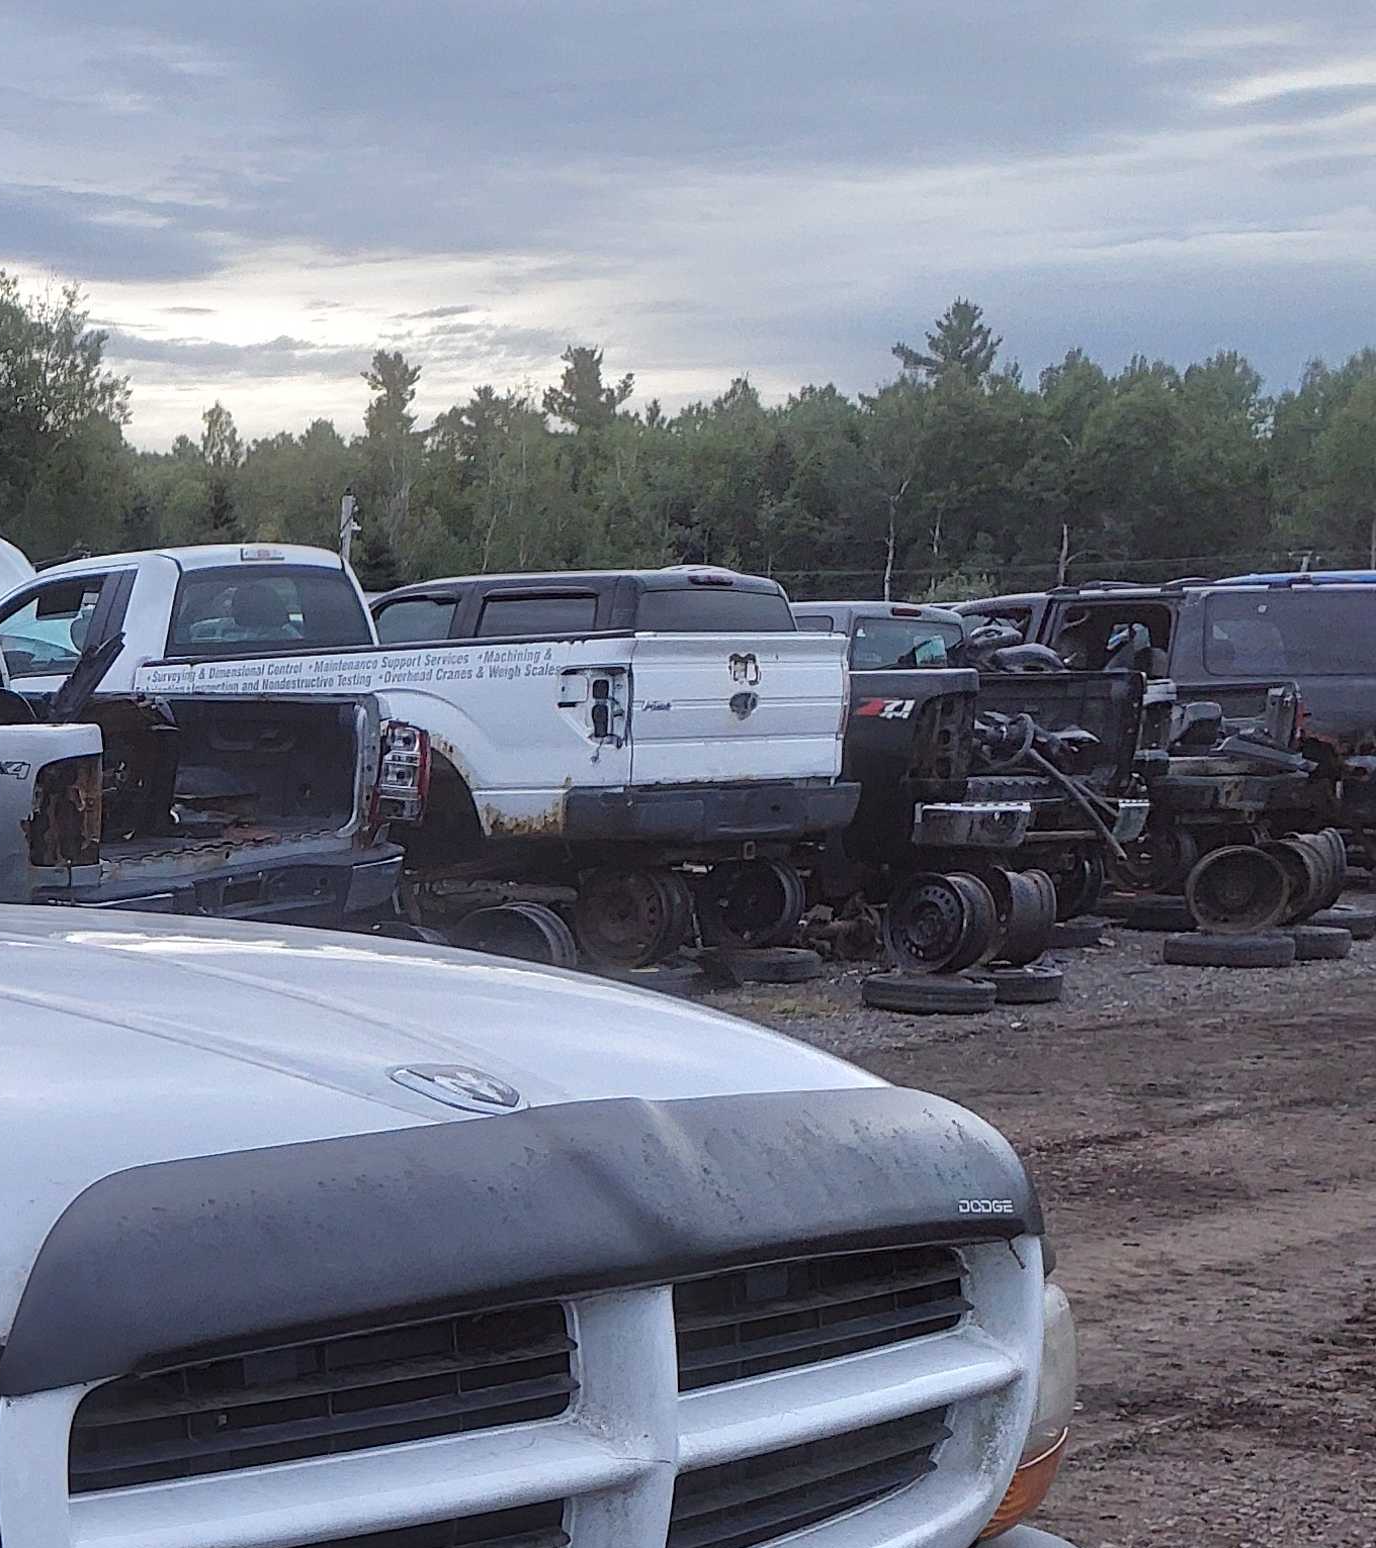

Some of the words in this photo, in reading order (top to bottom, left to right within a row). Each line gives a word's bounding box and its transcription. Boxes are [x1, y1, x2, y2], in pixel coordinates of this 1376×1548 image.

[151, 668, 196, 685] Surveying
[198, 666, 206, 681] &
[209, 663, 265, 680] Dimensional
[267, 661, 303, 676] Control
[313, 658, 379, 673] Maintenance
[380, 655, 422, 671] Support
[424, 652, 470, 667] Services
[482, 648, 541, 665] Machining
[544, 647, 553, 662] &
[241, 676, 260, 692] and
[262, 673, 334, 691] Nondestructive
[337, 671, 372, 688] Testing
[383, 668, 433, 684] Overhead
[435, 666, 473, 680] Cranes
[475, 664, 485, 678] &
[488, 662, 521, 679] Weigh
[524, 661, 561, 677] Scales
[957, 1199, 1015, 1213] DODGE
